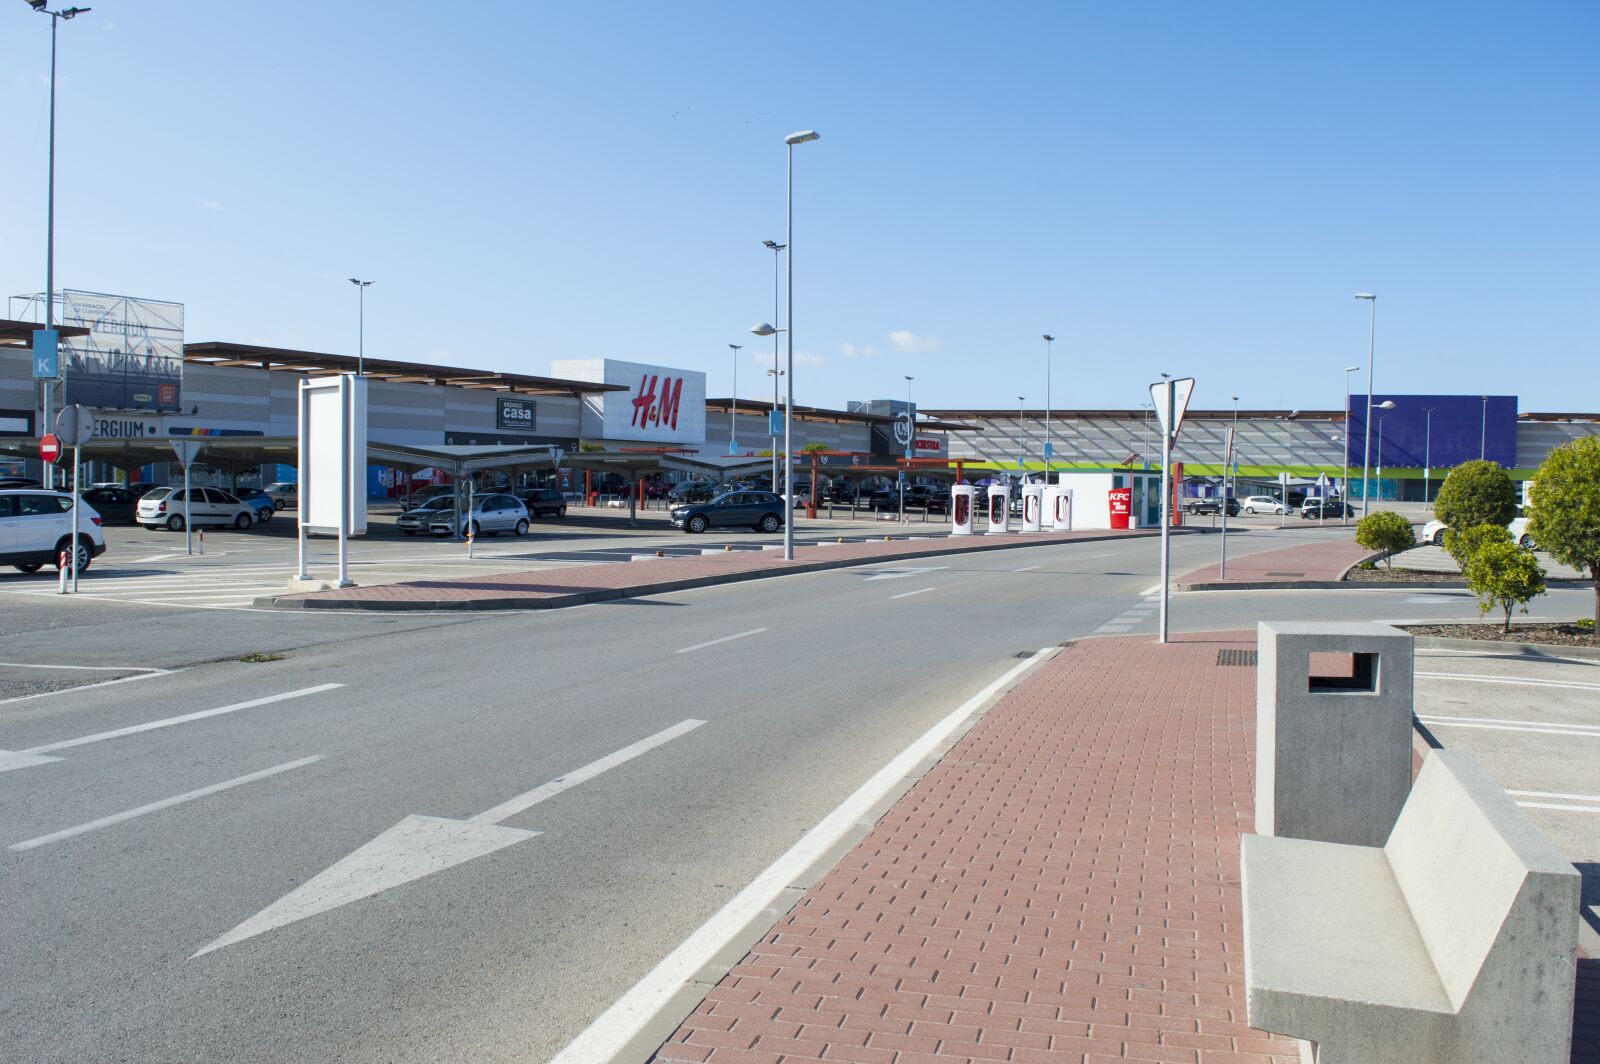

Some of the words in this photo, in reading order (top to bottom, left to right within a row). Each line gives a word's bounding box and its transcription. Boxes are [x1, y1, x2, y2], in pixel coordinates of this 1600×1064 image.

[38, 358, 50, 372] K
[632, 374, 683, 431] H&M
[503, 408, 531, 419] casa
[93, 420, 144, 437] ERGIUM
